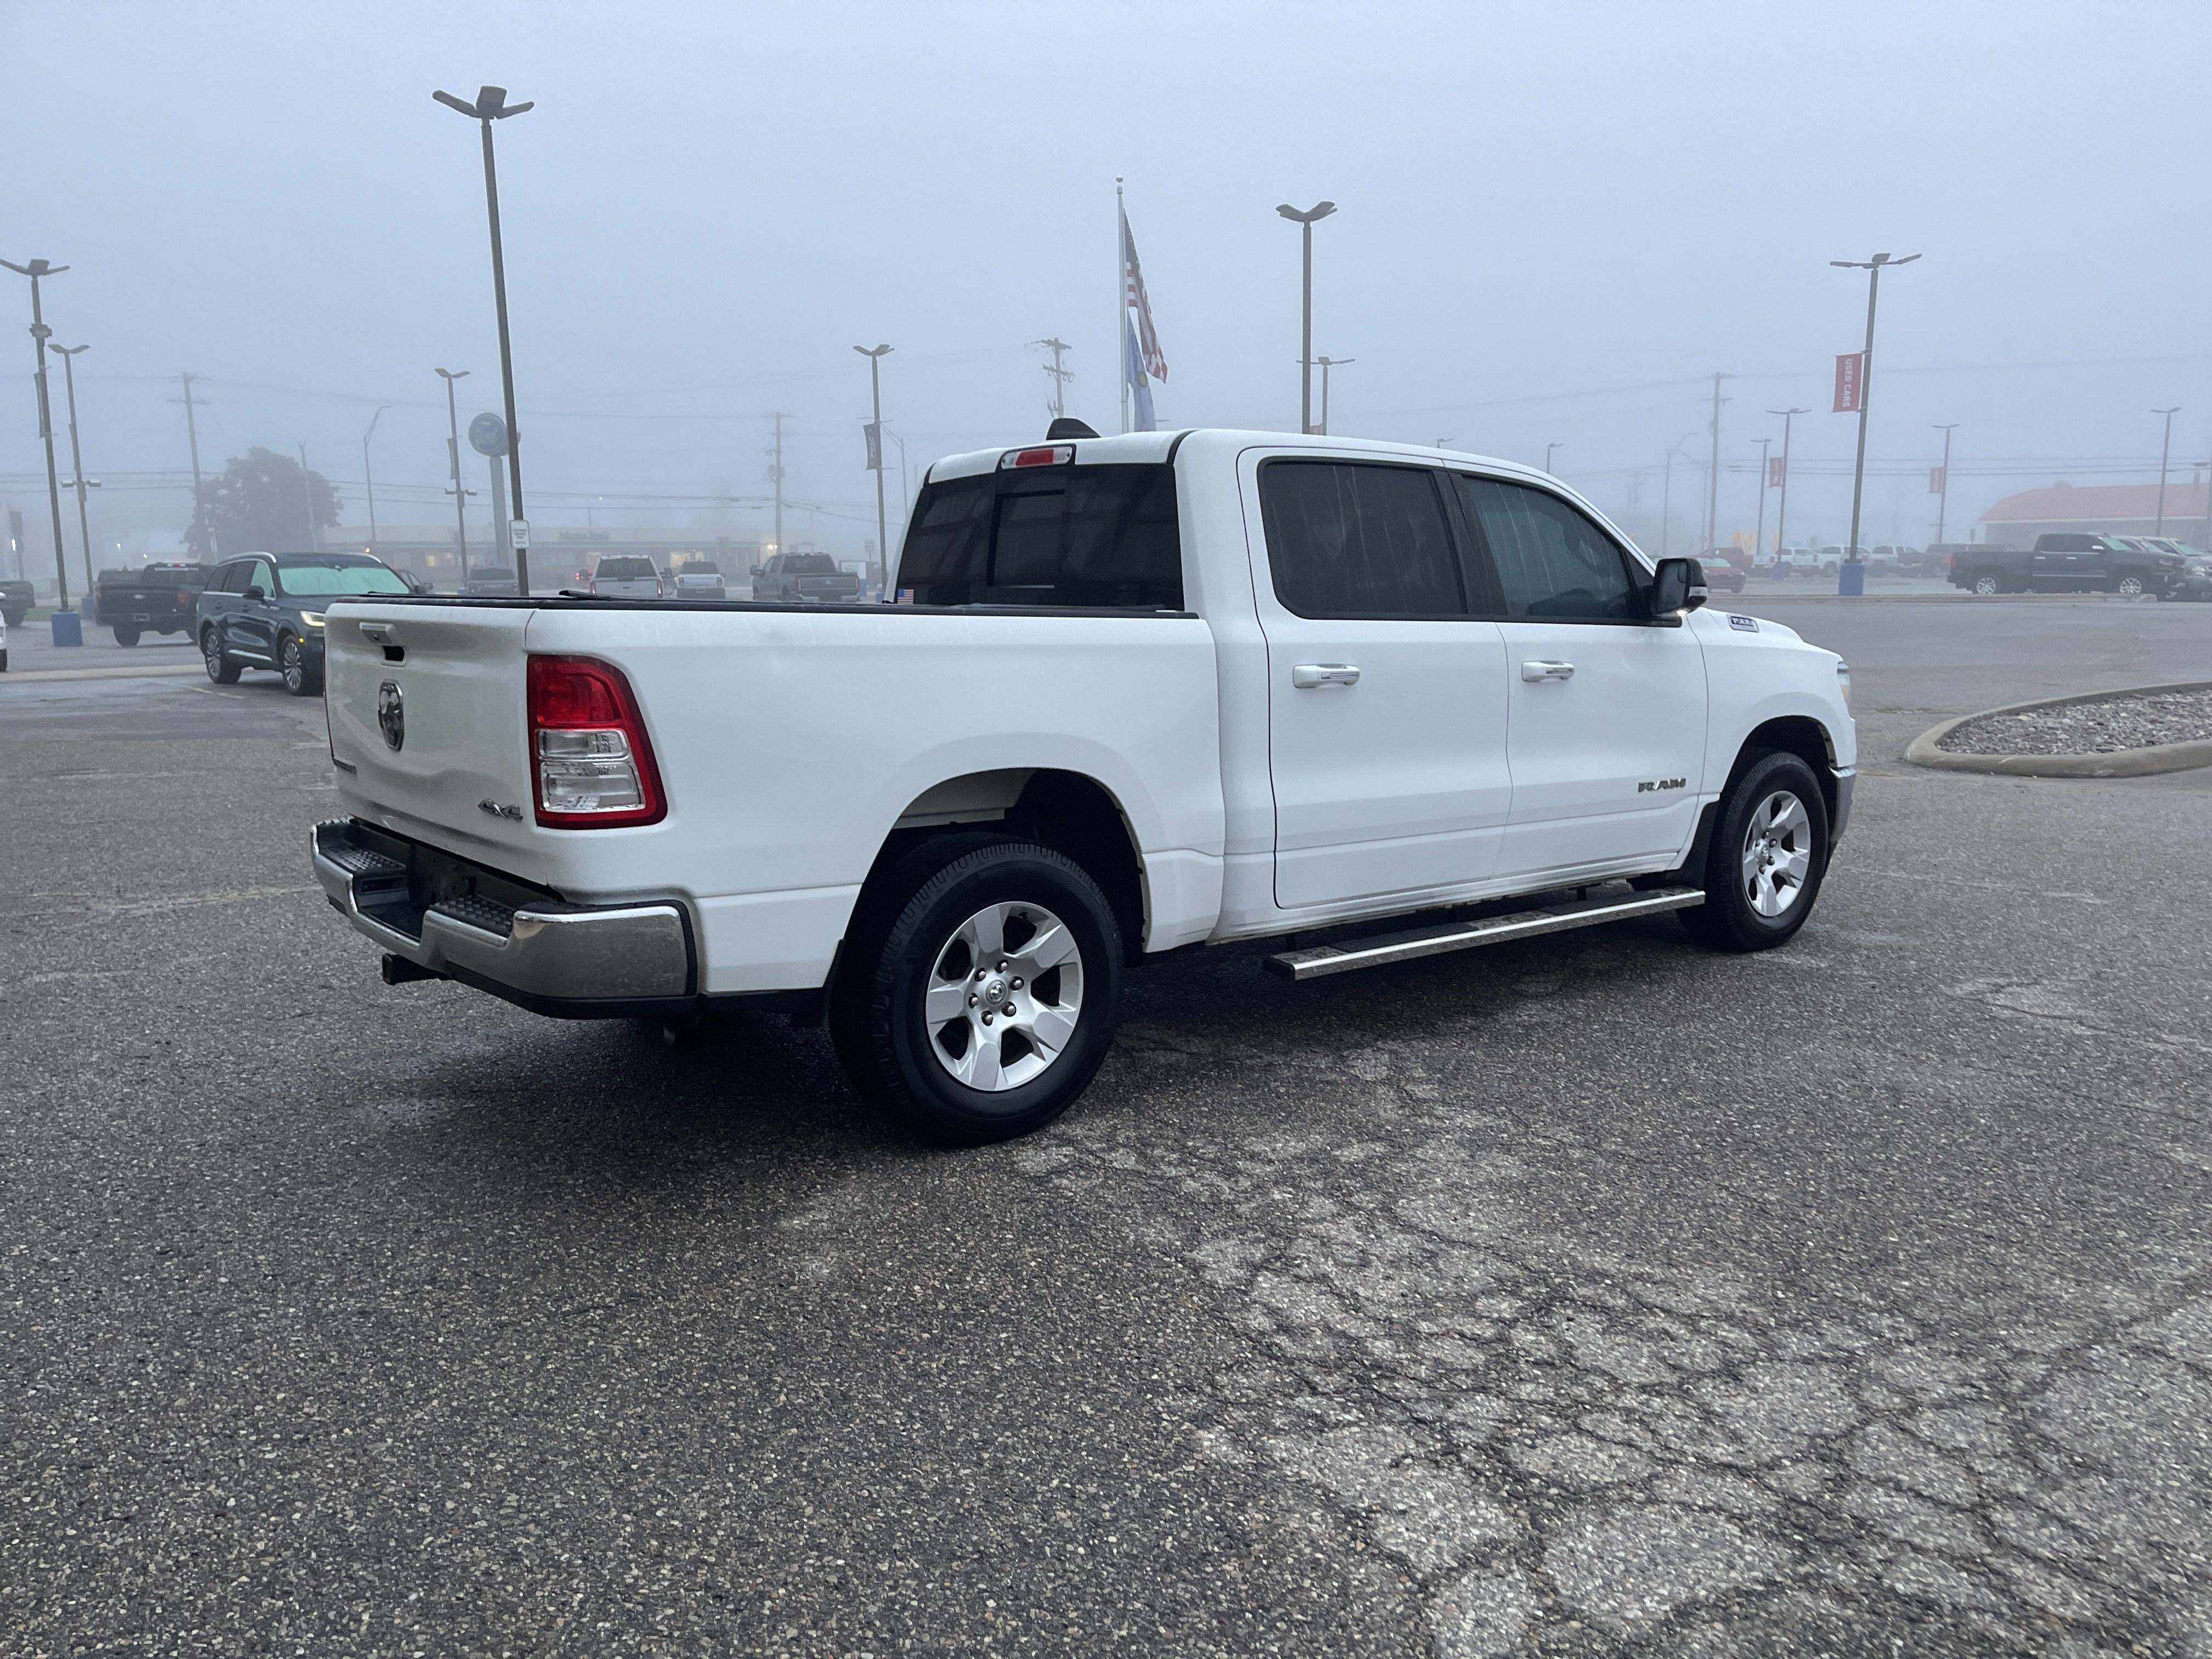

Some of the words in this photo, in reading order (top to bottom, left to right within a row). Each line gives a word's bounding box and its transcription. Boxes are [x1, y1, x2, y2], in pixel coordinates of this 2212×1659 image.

[1844, 358, 1853, 382] USED
[1843, 384, 1852, 407] CARS
[1638, 777, 1686, 793] RAM
